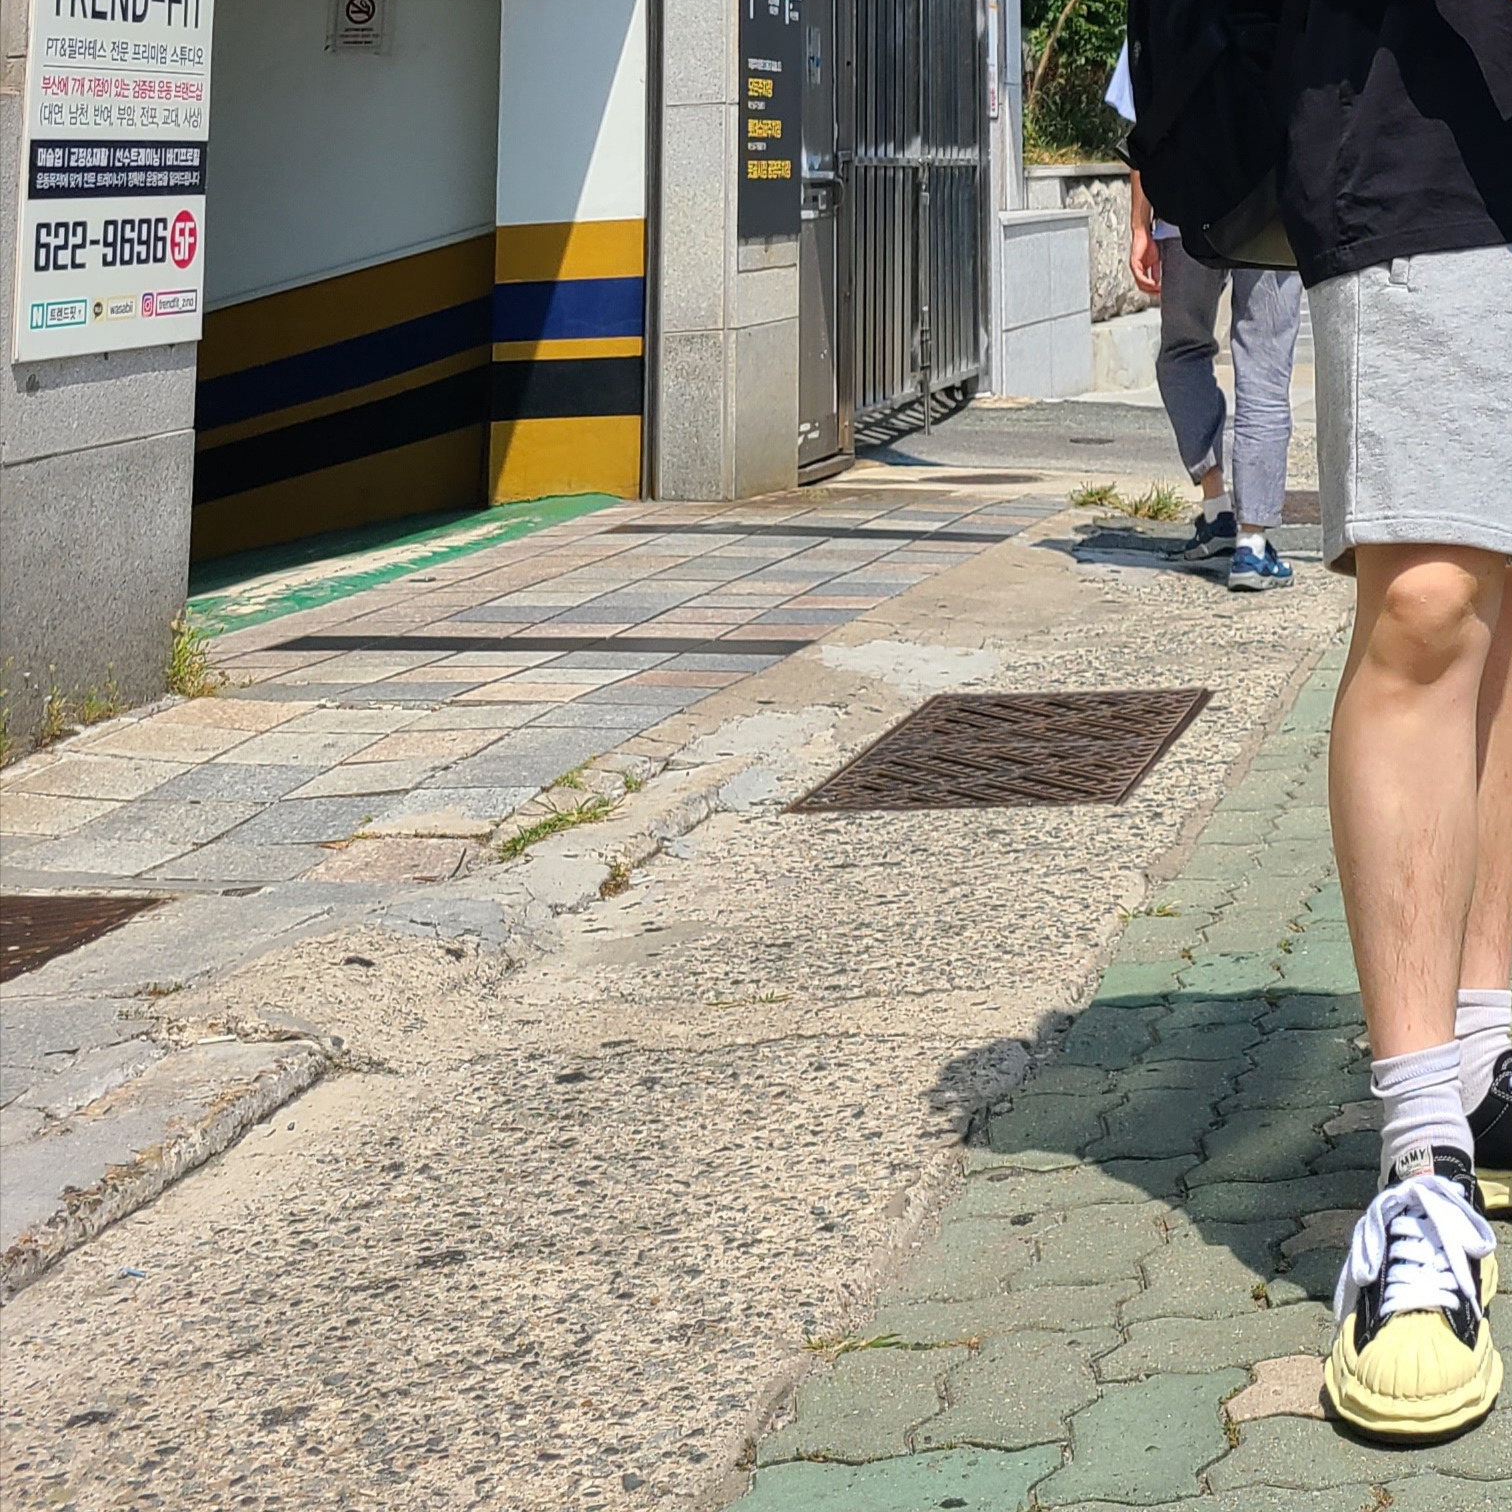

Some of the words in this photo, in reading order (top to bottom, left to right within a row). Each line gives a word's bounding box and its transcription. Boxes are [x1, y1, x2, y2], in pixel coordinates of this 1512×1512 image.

[45, 37, 107, 61] PT&필라테스
[110, 39, 130, 62] 전문
[131, 43, 168, 65] 프리미엄
[169, 45, 204, 66] 스튜디오
[41, 75, 69, 97] 부산에
[71, 75, 85, 97] 7개
[87, 76, 112, 98] 지점이
[114, 78, 130, 99] 있는
[132, 78, 156, 100] 검증된
[157, 80, 173, 101] 운동
[34, 217, 169, 273] 622-9696
[174, 221, 195, 261] 5F
